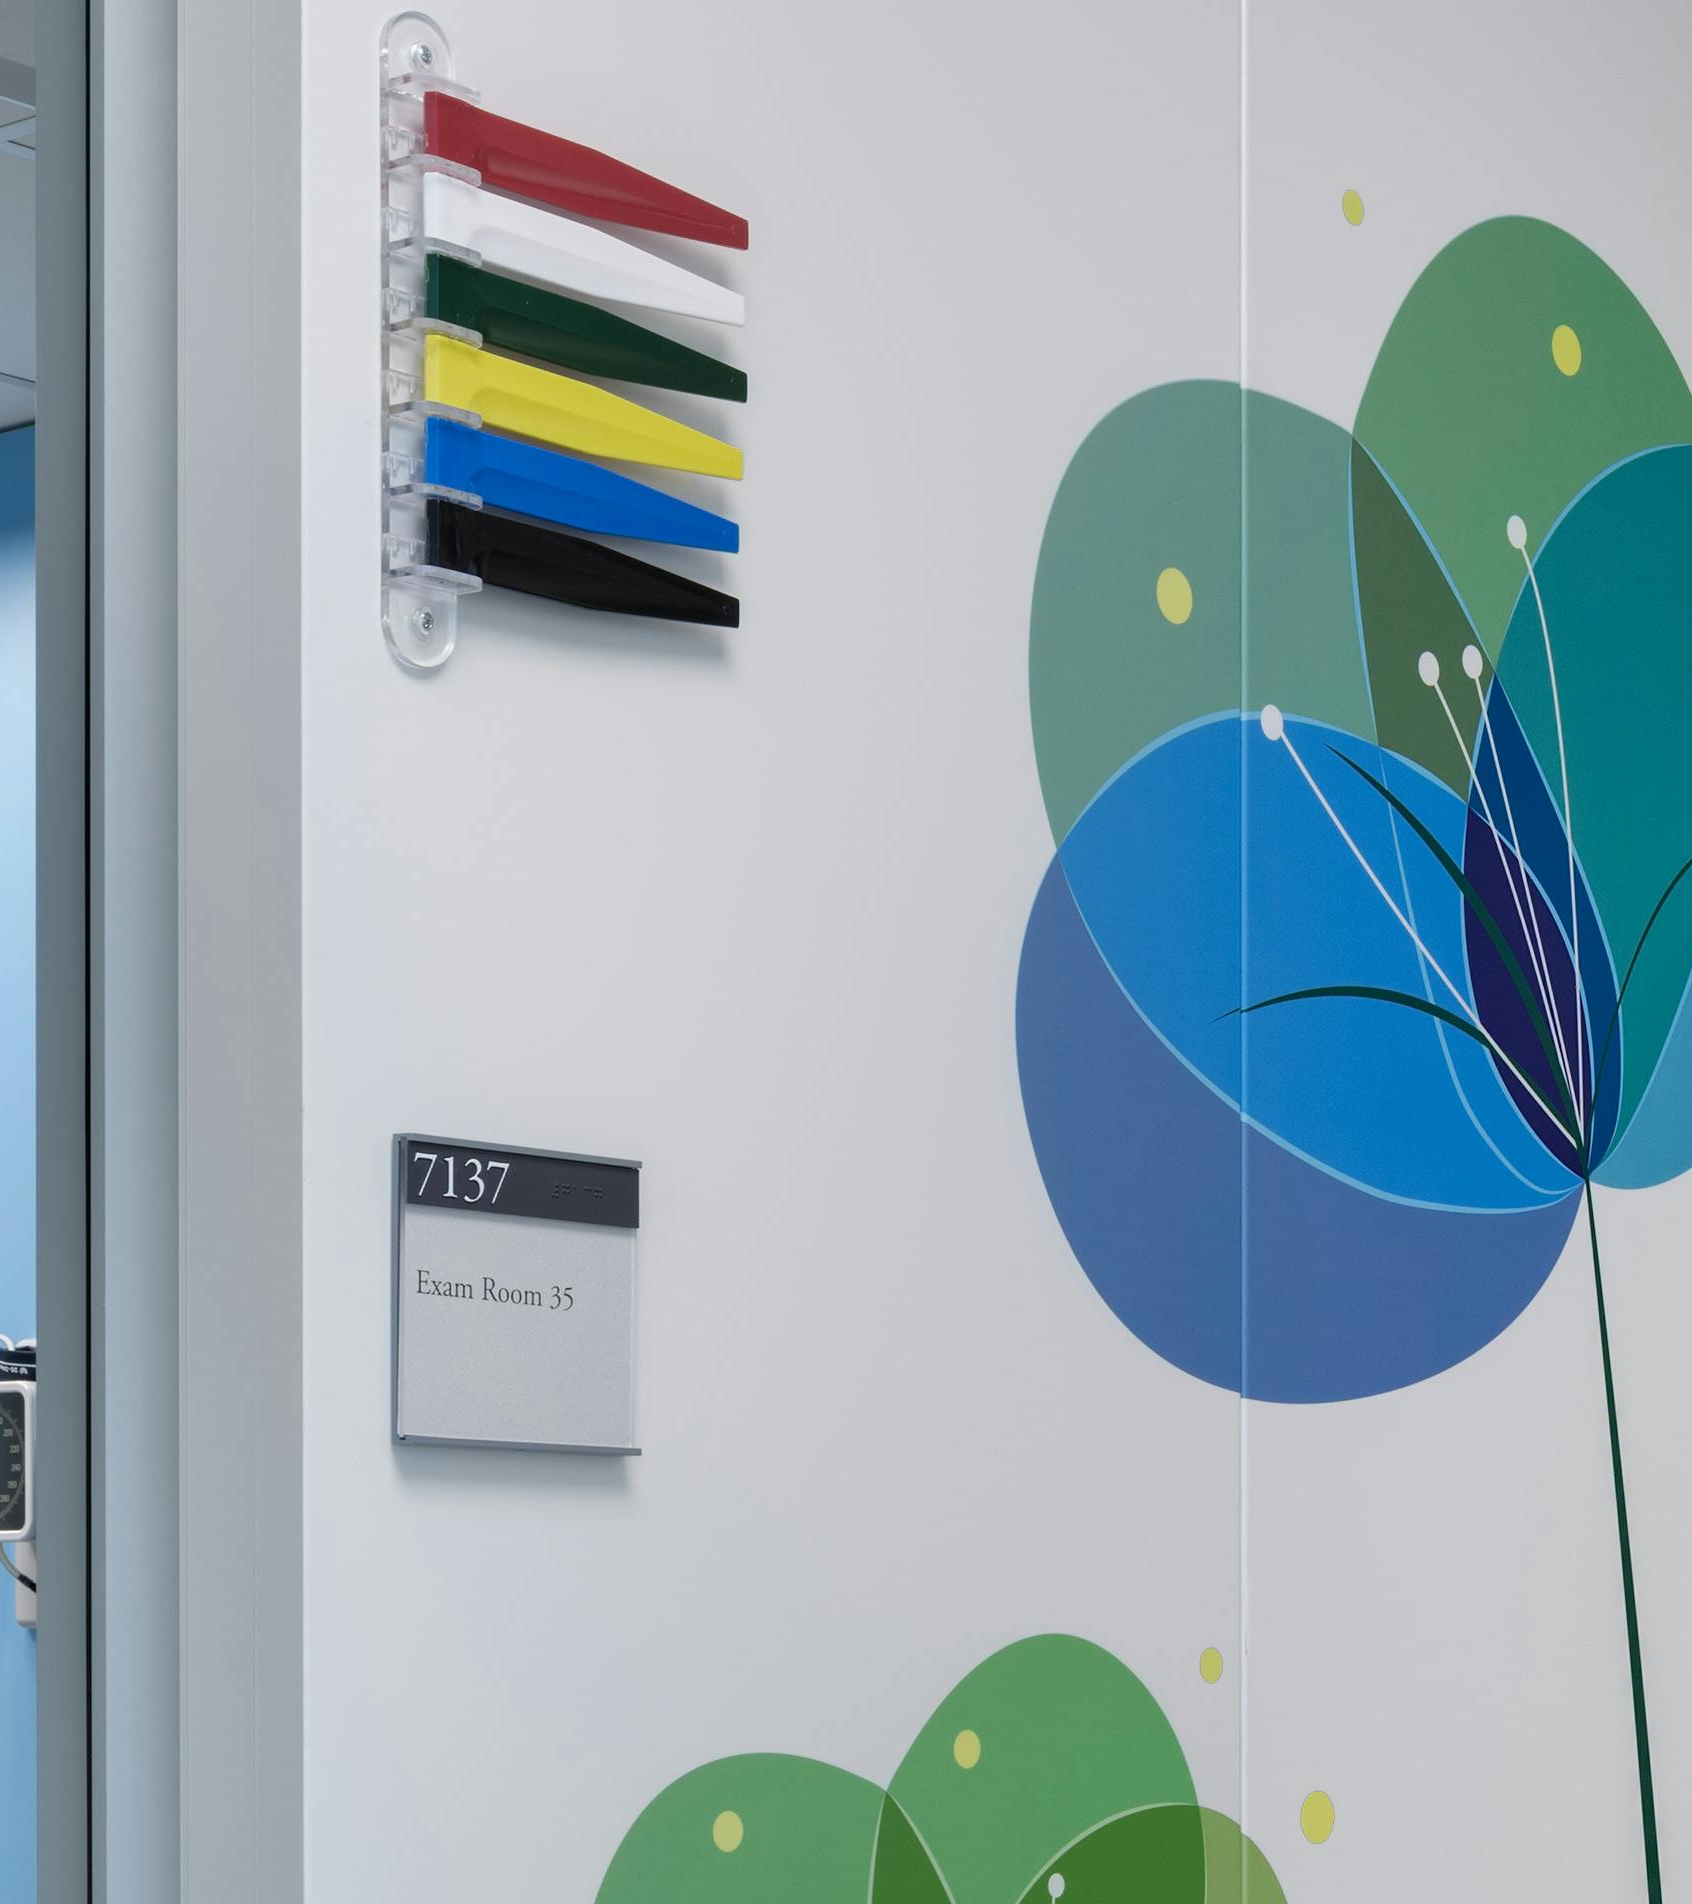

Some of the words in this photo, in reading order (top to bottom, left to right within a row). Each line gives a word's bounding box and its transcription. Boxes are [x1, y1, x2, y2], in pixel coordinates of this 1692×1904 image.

[413, 1151, 510, 1204] 7137
[416, 1269, 474, 1300] Exam
[482, 1276, 543, 1307] Room
[550, 1285, 574, 1312] 35
